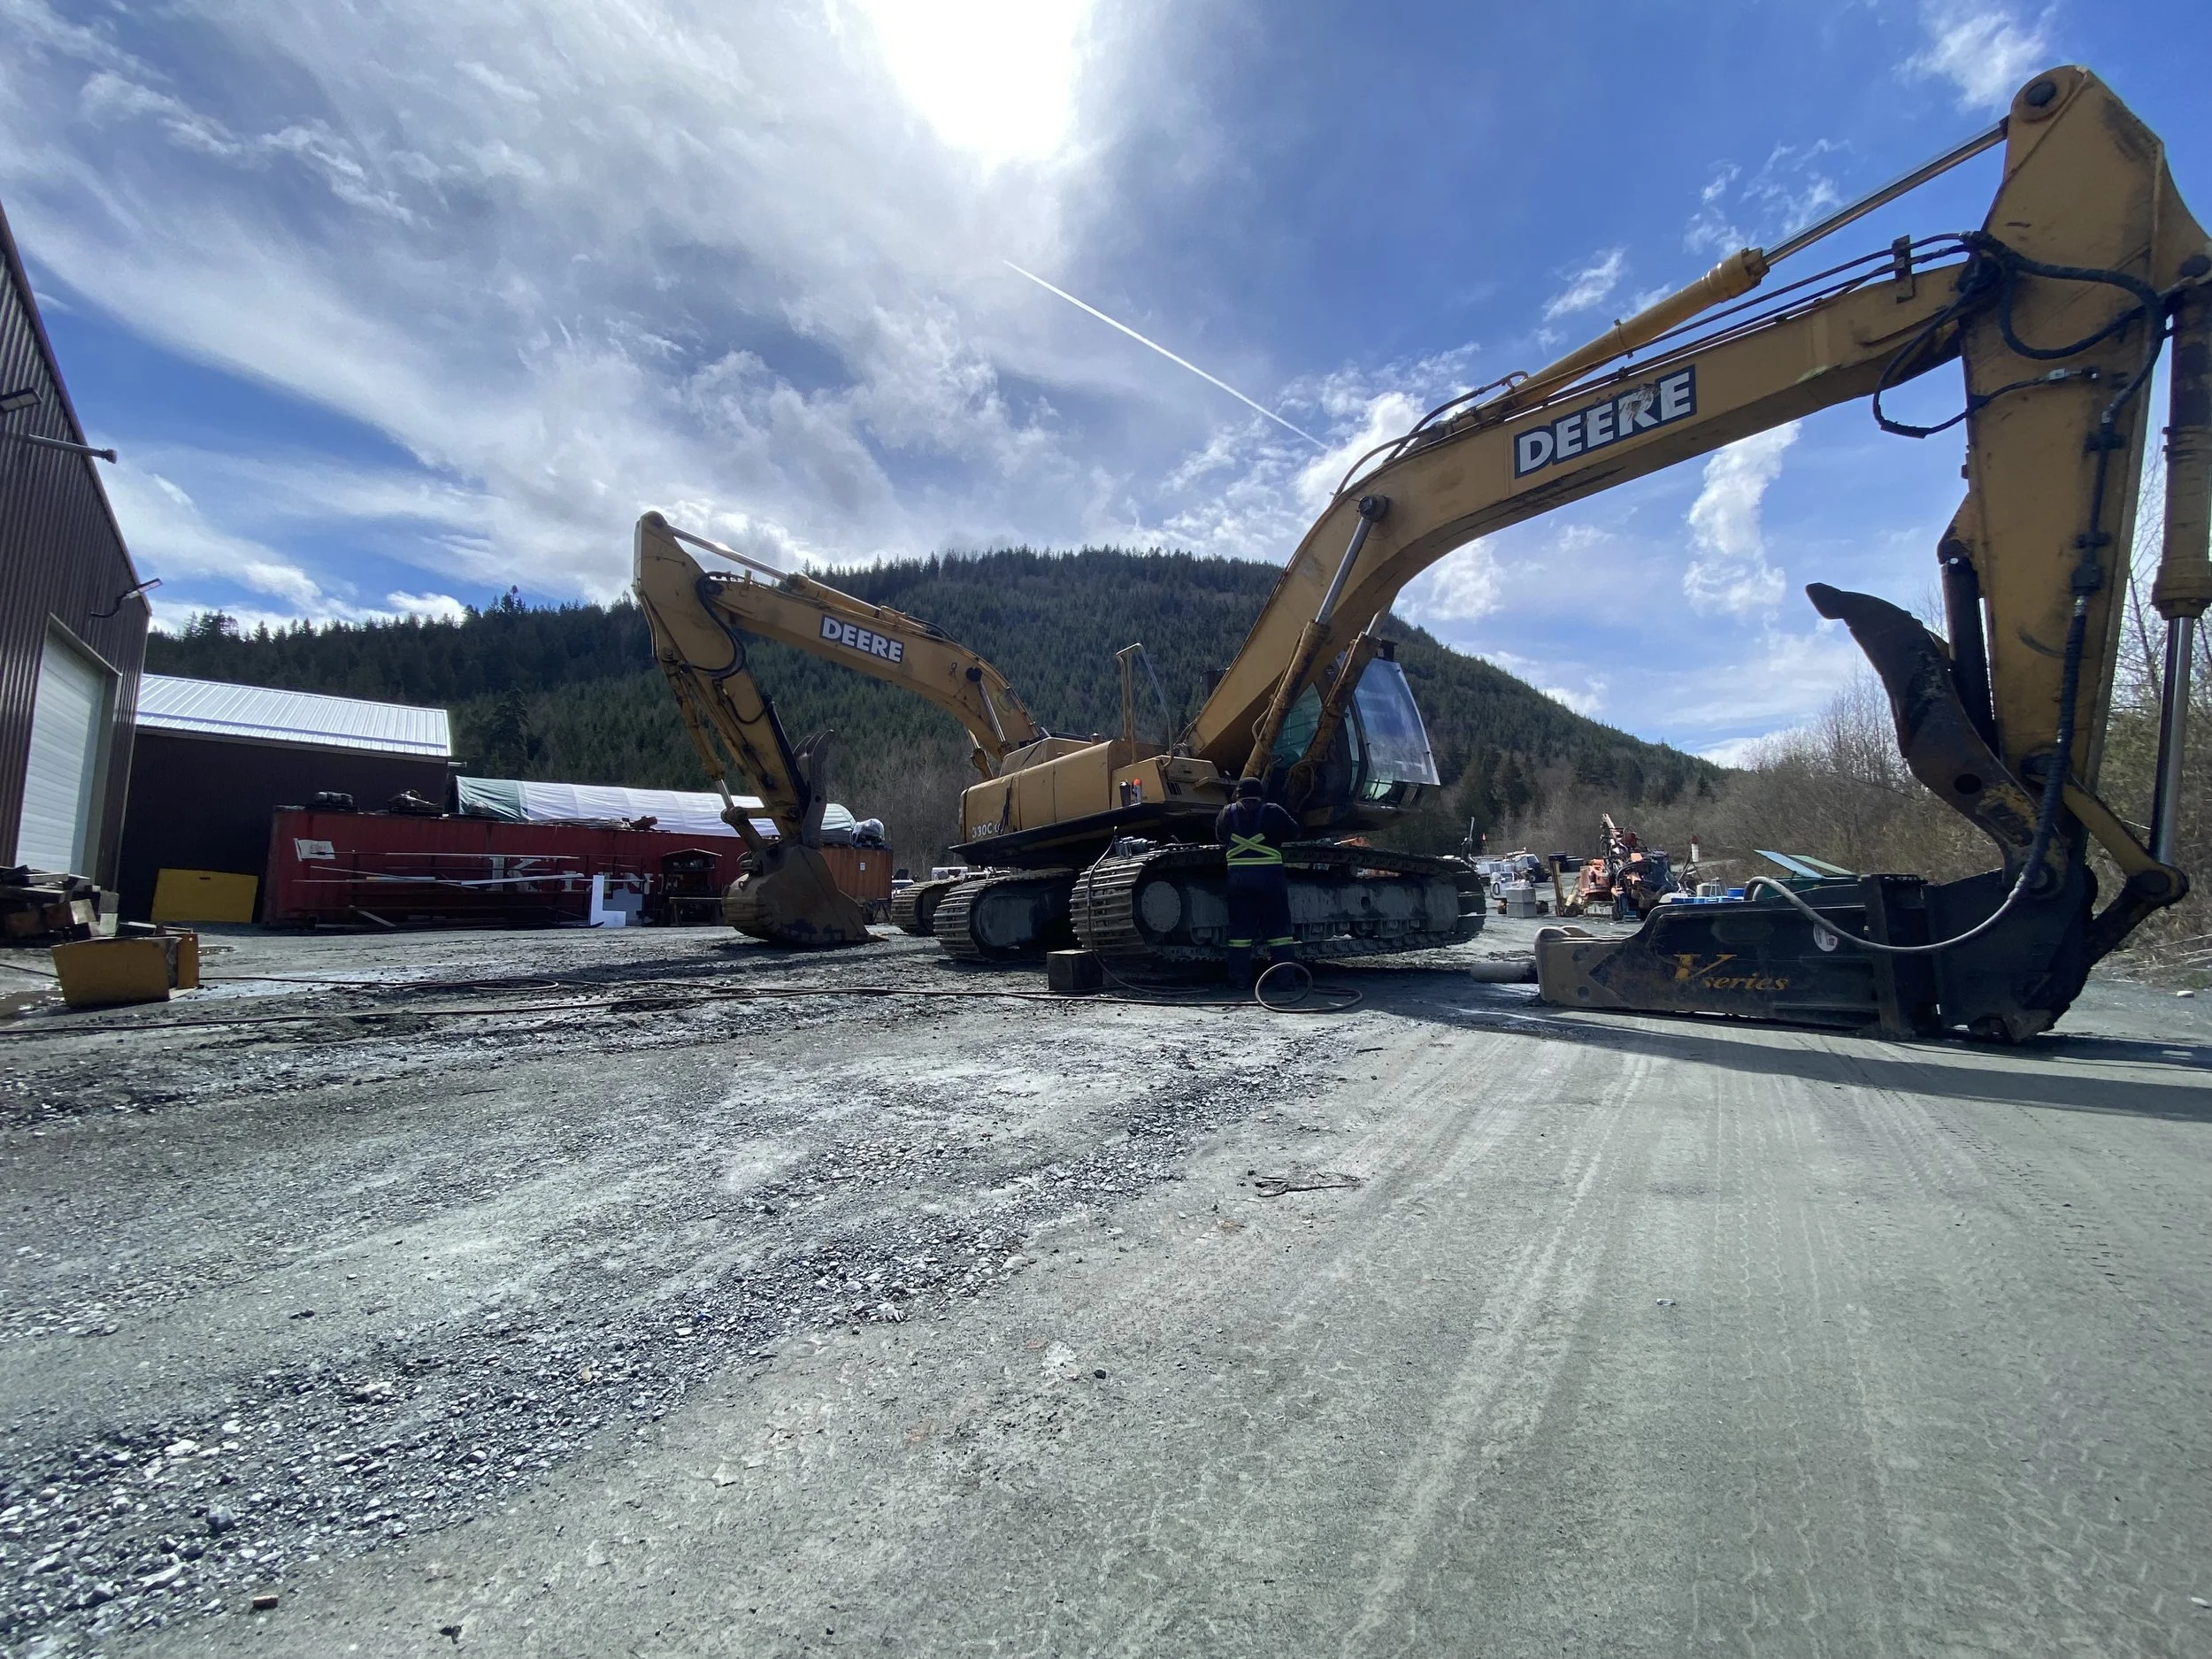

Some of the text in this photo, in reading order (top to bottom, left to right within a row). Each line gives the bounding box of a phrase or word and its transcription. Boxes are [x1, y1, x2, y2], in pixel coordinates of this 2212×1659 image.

[1519, 372, 1691, 472] DEERE
[822, 617, 903, 663] DEERE
[972, 822, 993, 839] 330C
